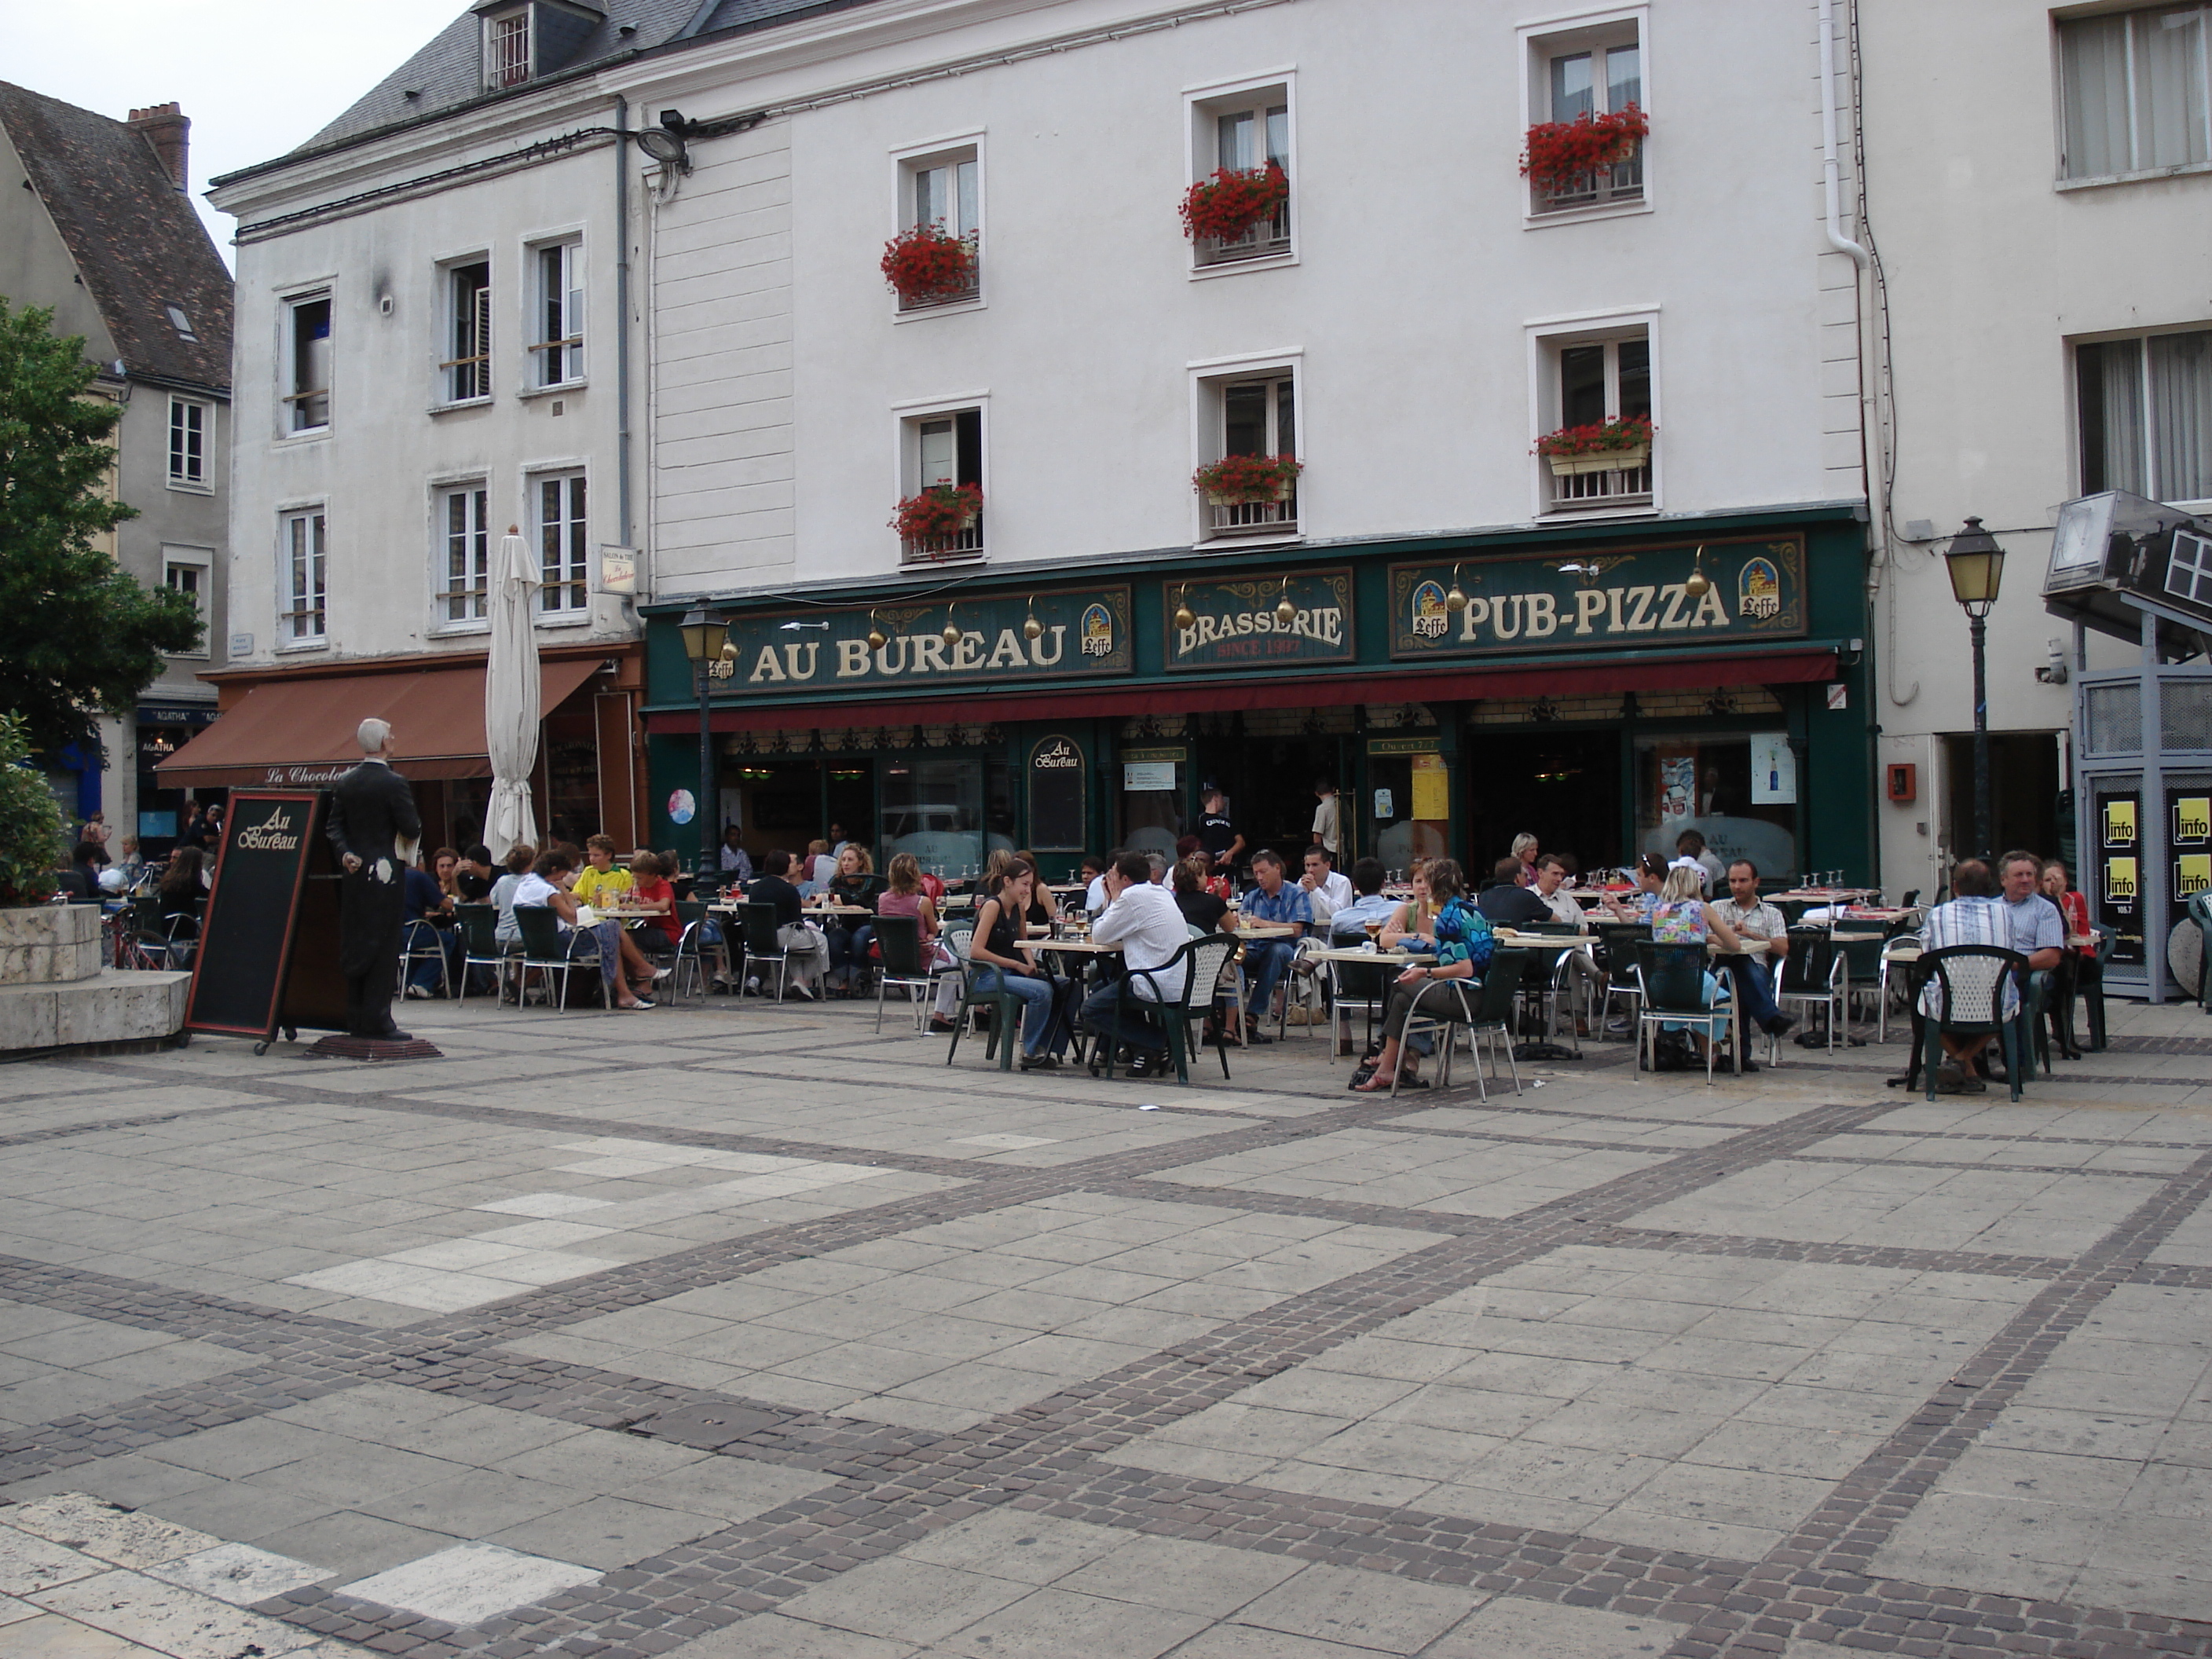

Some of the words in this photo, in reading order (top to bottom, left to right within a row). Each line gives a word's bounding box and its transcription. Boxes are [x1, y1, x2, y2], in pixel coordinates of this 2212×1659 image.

[1459, 581, 1730, 642] PUB-PIZZA
[1744, 597, 1777, 618] Leffe
[1178, 607, 1343, 656] BRASSERIE
[1415, 617, 1446, 637] Leffe
[749, 642, 820, 683] AU
[836, 625, 1067, 677] BUREAU
[1084, 638, 1111, 655] Leffe
[1218, 640, 1262, 657] SINCE
[709, 661, 733, 677] Leffe
[142, 743, 174, 753] AGATHA
[1050, 741, 1070, 756] Au
[1035, 754, 1078, 768] Bureau
[265, 767, 284, 783] La
[289, 766, 355, 782] Chocola
[262, 805, 291, 830] Au
[2181, 818, 2208, 834] info
[238, 826, 298, 849] Bureau
[2110, 822, 2133, 837] info
[2111, 877, 2134, 893] info
[2182, 874, 2209, 891] info
[2117, 906, 2133, 914] 105.7
